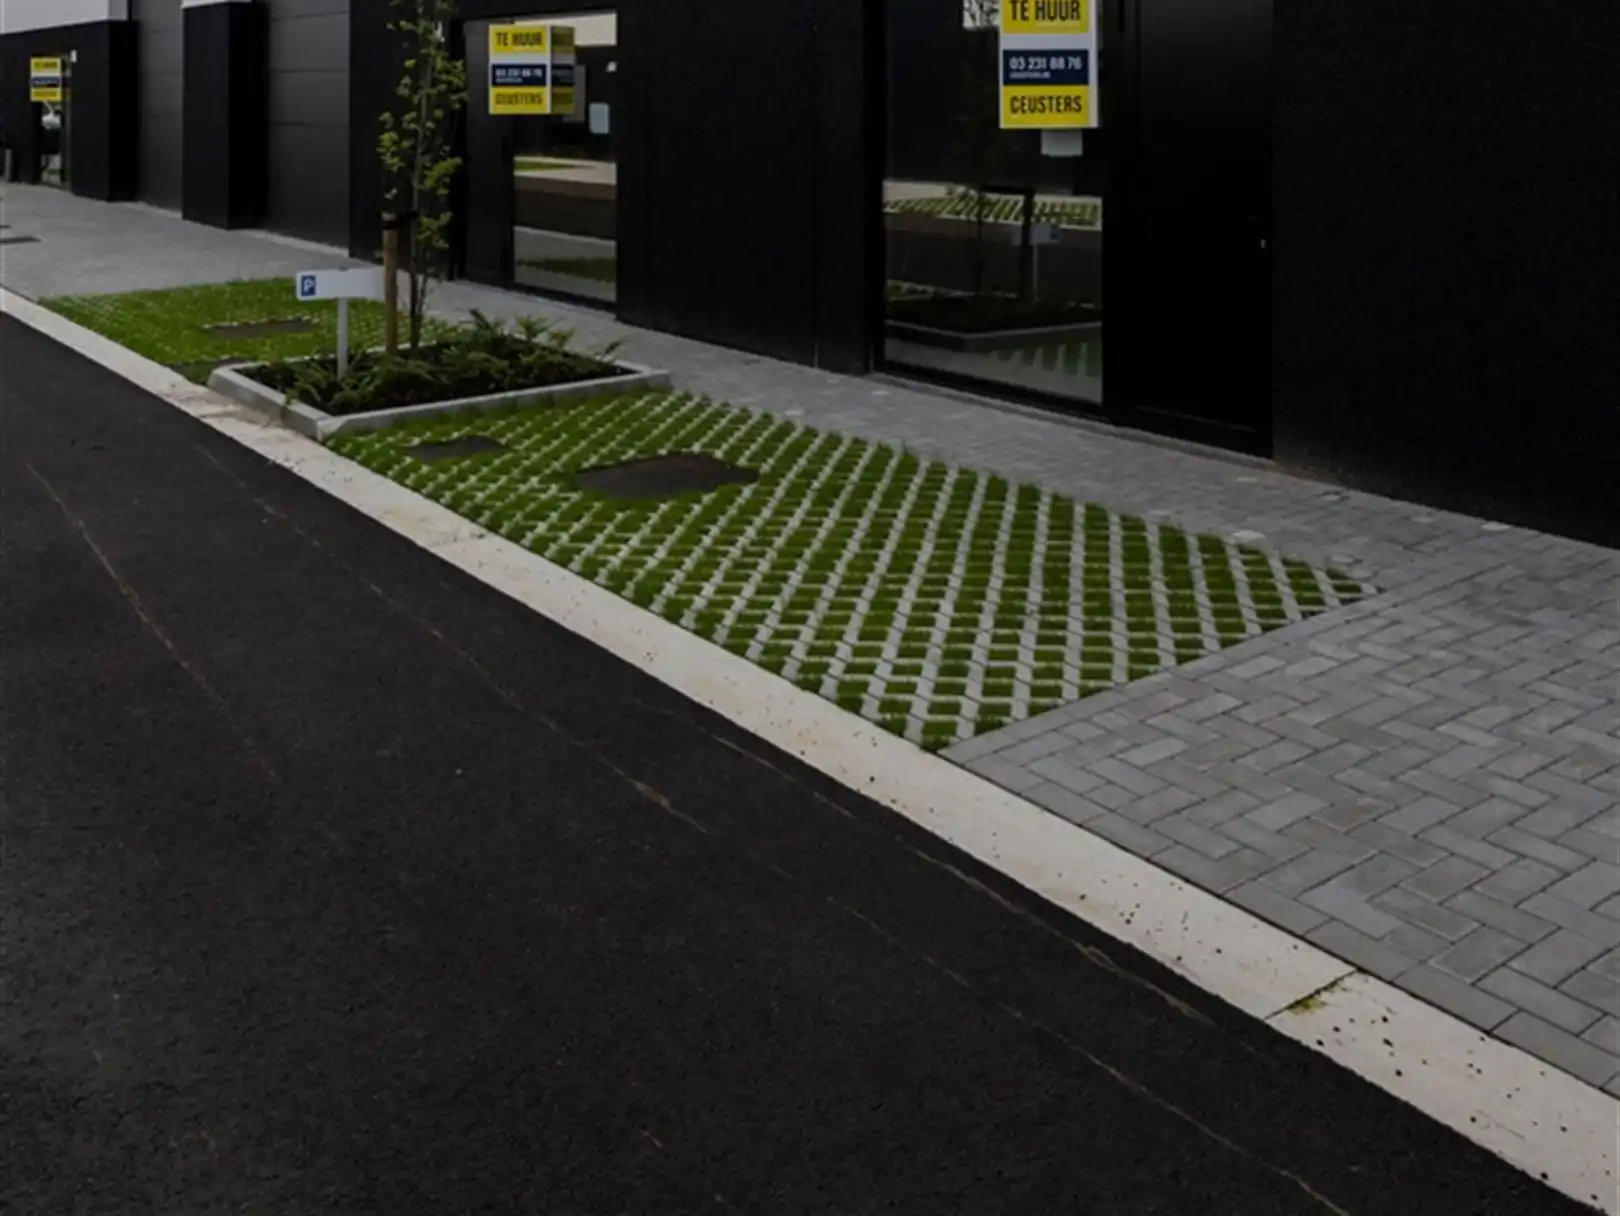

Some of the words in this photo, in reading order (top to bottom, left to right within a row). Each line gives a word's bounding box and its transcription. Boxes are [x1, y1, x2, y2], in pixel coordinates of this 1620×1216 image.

[1009, 0, 1029, 21] TE
[1035, 0, 1081, 21] HUUR
[496, 32, 508, 46] TE
[1009, 56, 1026, 70] 03
[1028, 56, 1047, 70] 231
[1010, 95, 1082, 115] CEUSTERS
